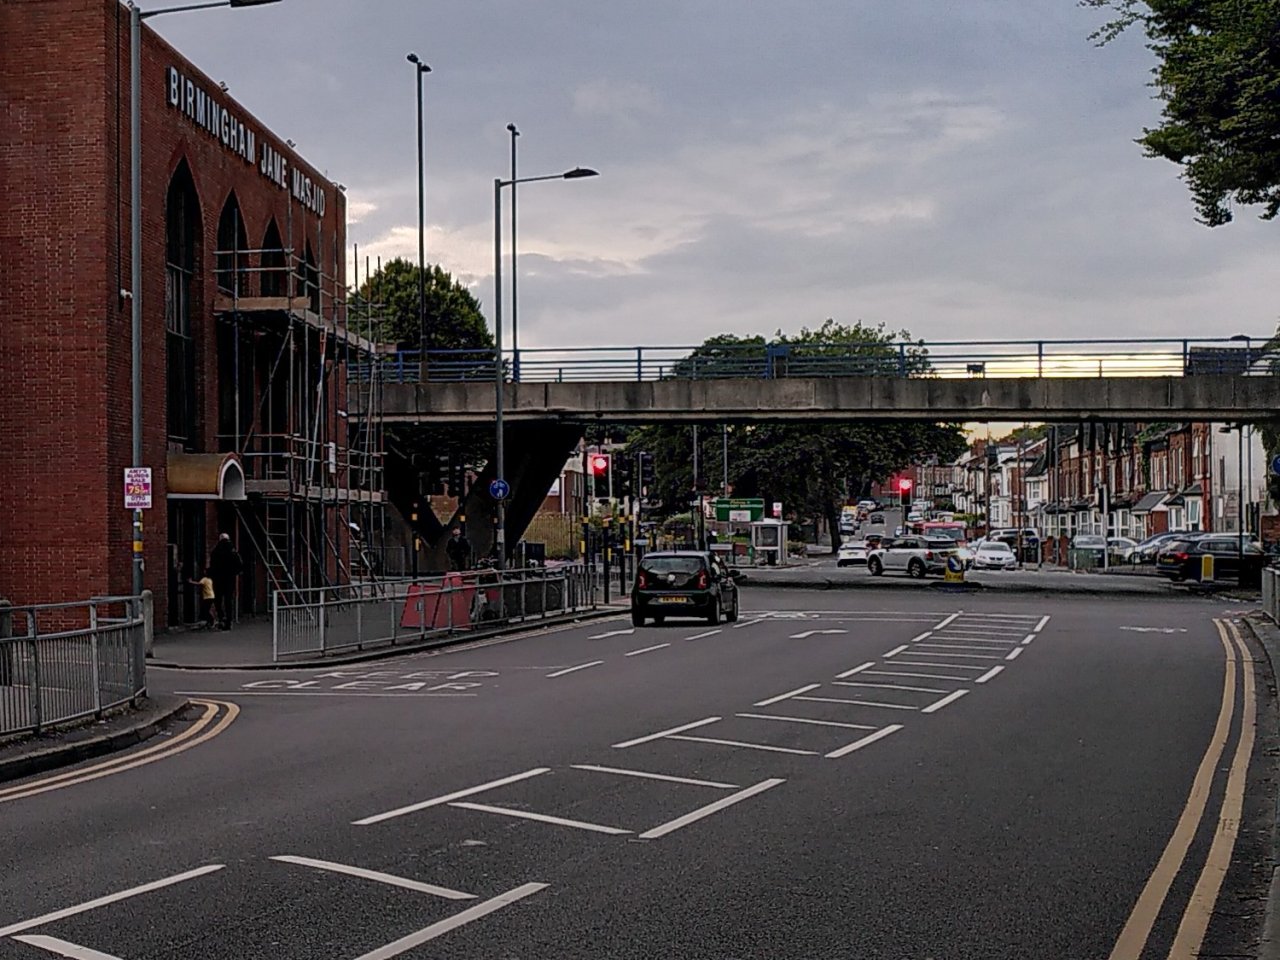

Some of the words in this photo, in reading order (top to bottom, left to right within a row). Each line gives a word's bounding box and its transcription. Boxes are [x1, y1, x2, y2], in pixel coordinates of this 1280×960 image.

[169, 66, 256, 164] BIRMINGHAM
[260, 142, 288, 190] JAME
[291, 167, 326, 218] MASJID
[314, 670, 500, 680] KEEP
[241, 679, 483, 691] CLEAR
